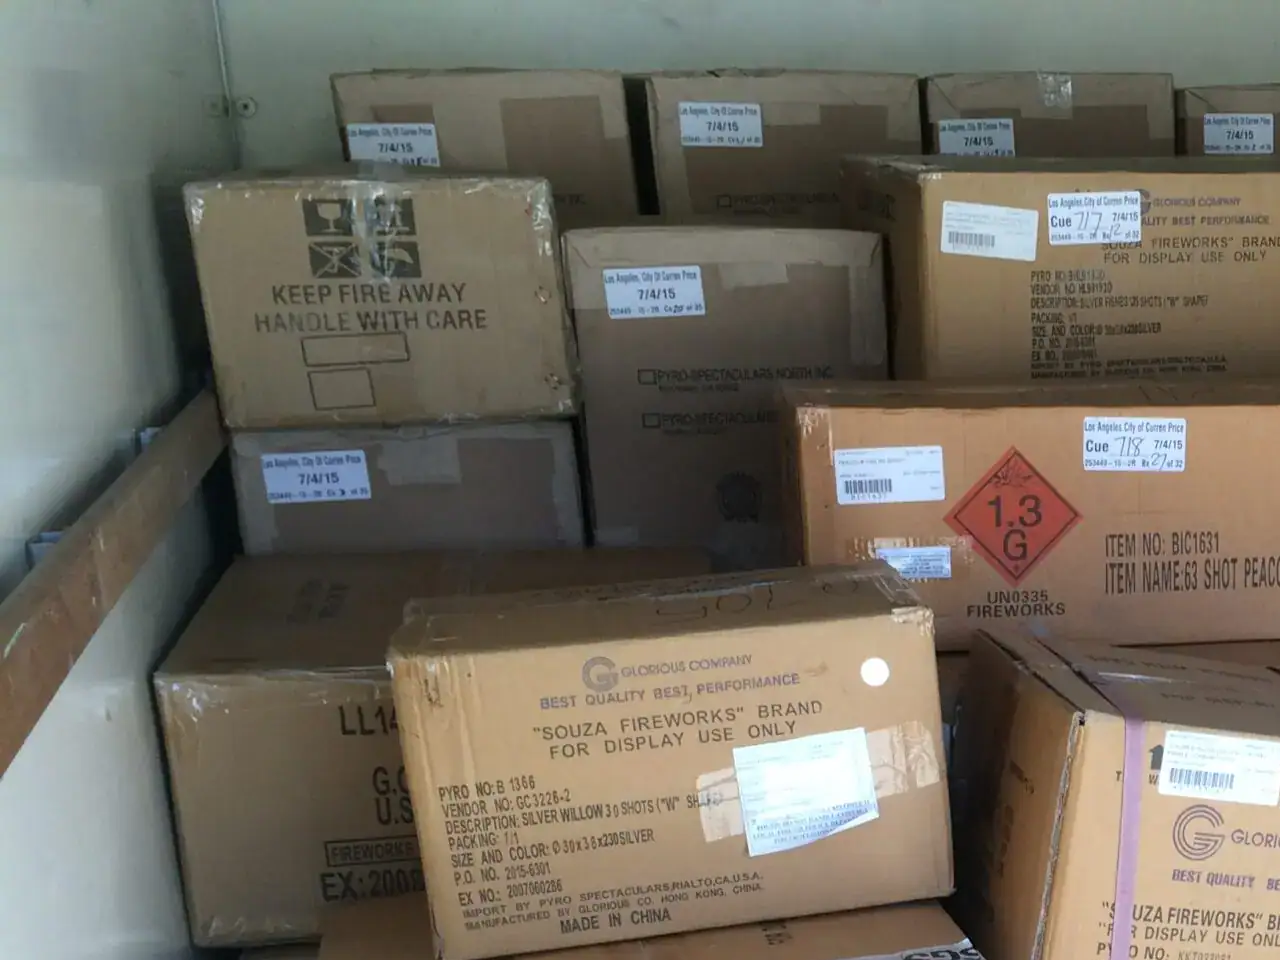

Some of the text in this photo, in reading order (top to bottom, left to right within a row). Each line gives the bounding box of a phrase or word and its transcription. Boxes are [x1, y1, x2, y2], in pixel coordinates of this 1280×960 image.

[1051, 216, 1071, 227] Cue
[1104, 250, 1267, 264] FOR DISPLAY USE ONLY
[272, 283, 466, 304] KEEP FIRE AWAY
[638, 288, 675, 300] 7/4/15
[254, 309, 488, 332] HANDLE WITH CARE
[1167, 422, 1184, 433] Price
[1086, 440, 1182, 452] Cue 7/4/15
[1114, 437, 1144, 457] 718
[988, 495, 1043, 528] 1.3
[1003, 529, 1028, 562] G
[1105, 530, 1220, 558] ITEM NO: BIC1631
[1104, 562, 1136, 595] ITEM
[1203, 557, 1239, 590] SHOT
[987, 590, 1048, 605] UN0335
[967, 602, 1066, 617] FIREWORKS
[620, 653, 753, 678] GLORIOUS COMPANY
[540, 672, 800, 710] BEST QUALITY PERFORMANCE
[757, 700, 823, 719] BRAND
[549, 720, 797, 760] FOR DISPLAY USE ONLY
[1171, 868, 1202, 884] BEST
[1205, 871, 1255, 888] QUALITY
[560, 908, 671, 934] MADE CHINA
[1144, 926, 1244, 946] DISPLAY USE
